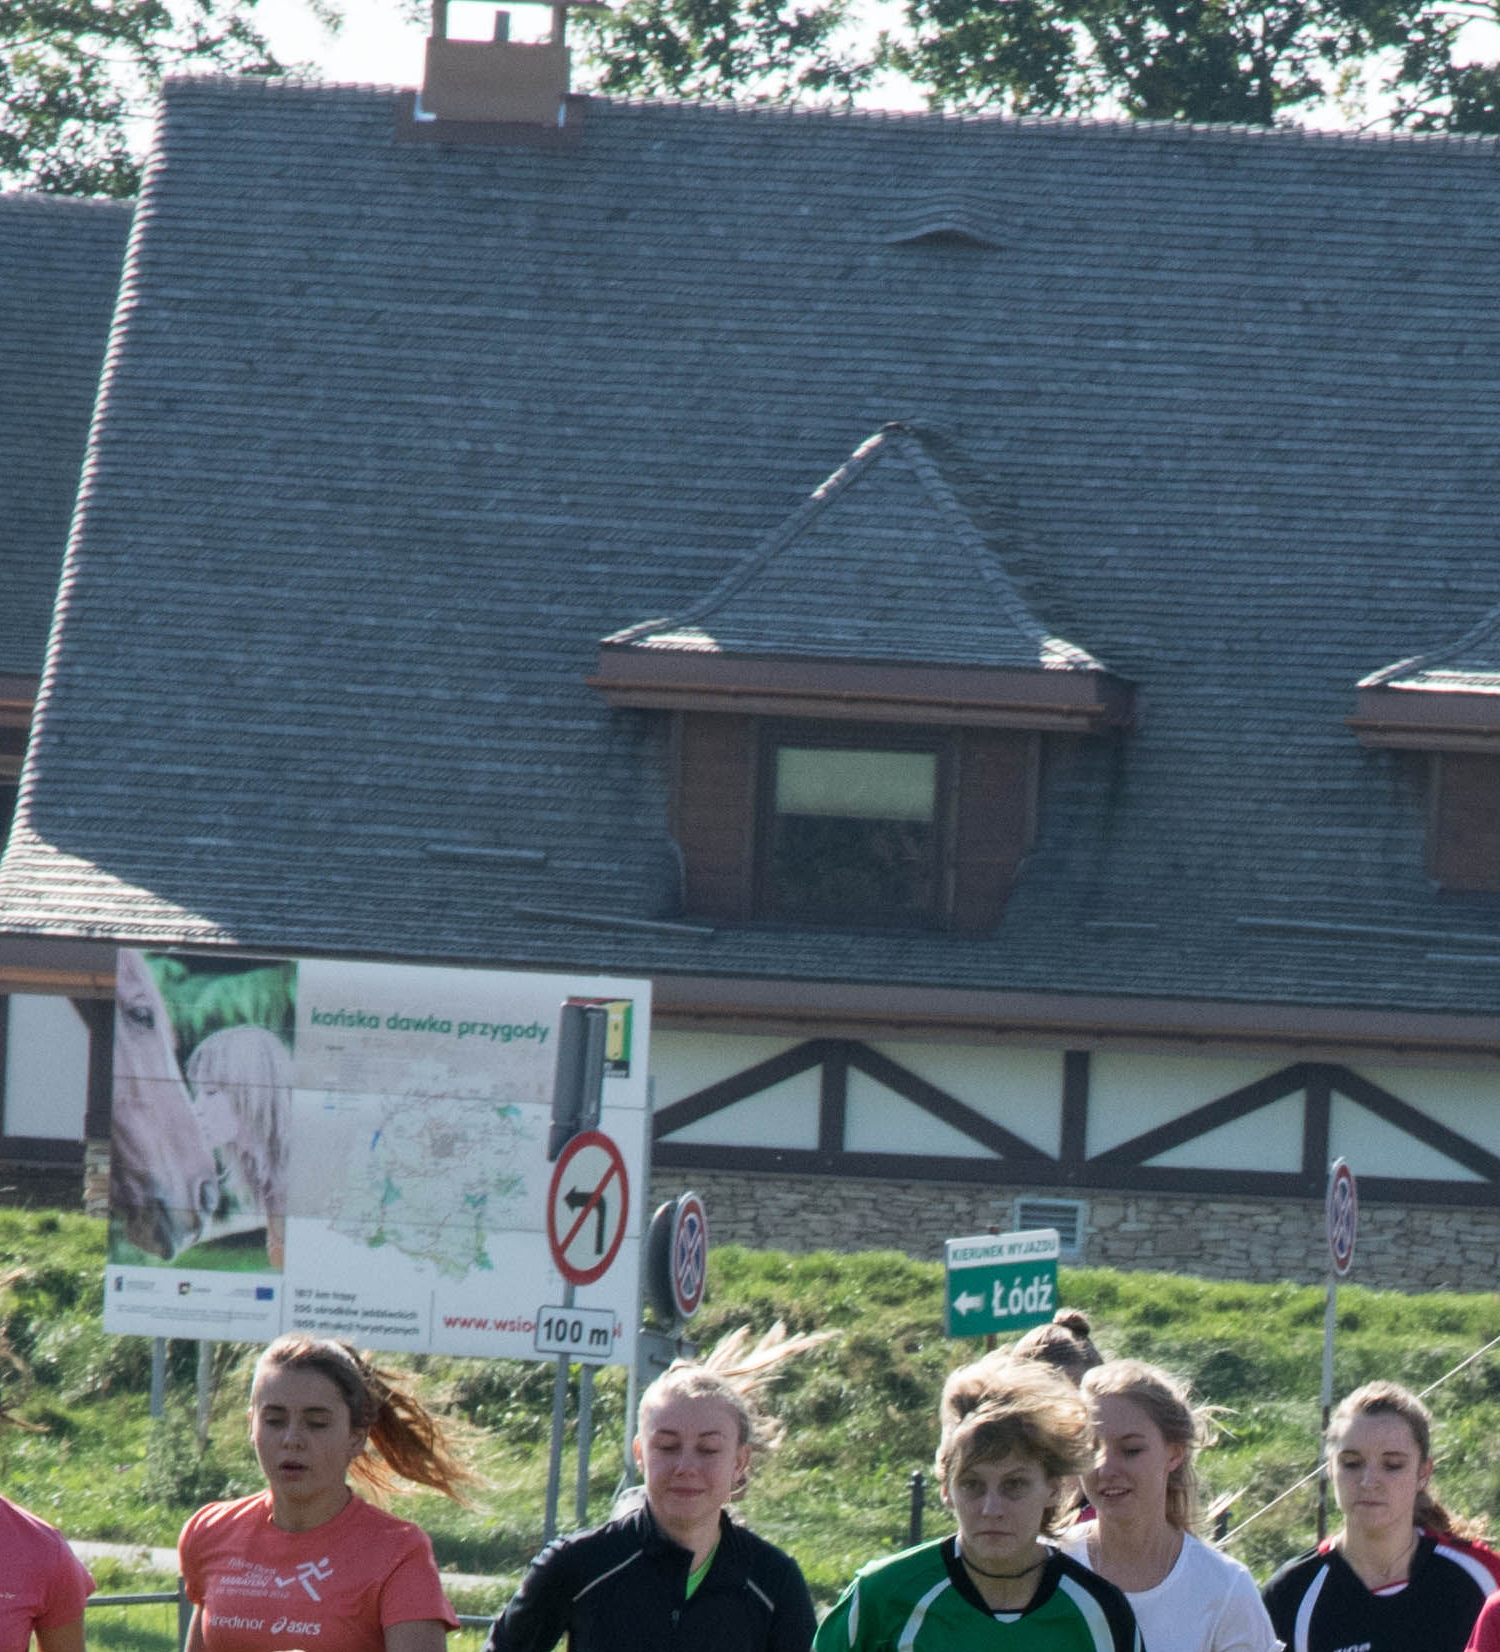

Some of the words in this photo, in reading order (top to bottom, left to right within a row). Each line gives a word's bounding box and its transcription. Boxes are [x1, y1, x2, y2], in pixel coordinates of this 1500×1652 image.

[310, 1007, 380, 1030] końska
[385, 1012, 451, 1034] dawka
[457, 1021, 549, 1044] przygody
[951, 1245, 1004, 1262] KIERUNEK
[1006, 1239, 1057, 1257] WYJAZDU
[991, 1273, 1053, 1318] Łódź
[543, 1316, 583, 1343] 100
[588, 1327, 609, 1346] m
[287, 1621, 322, 1636] asics
